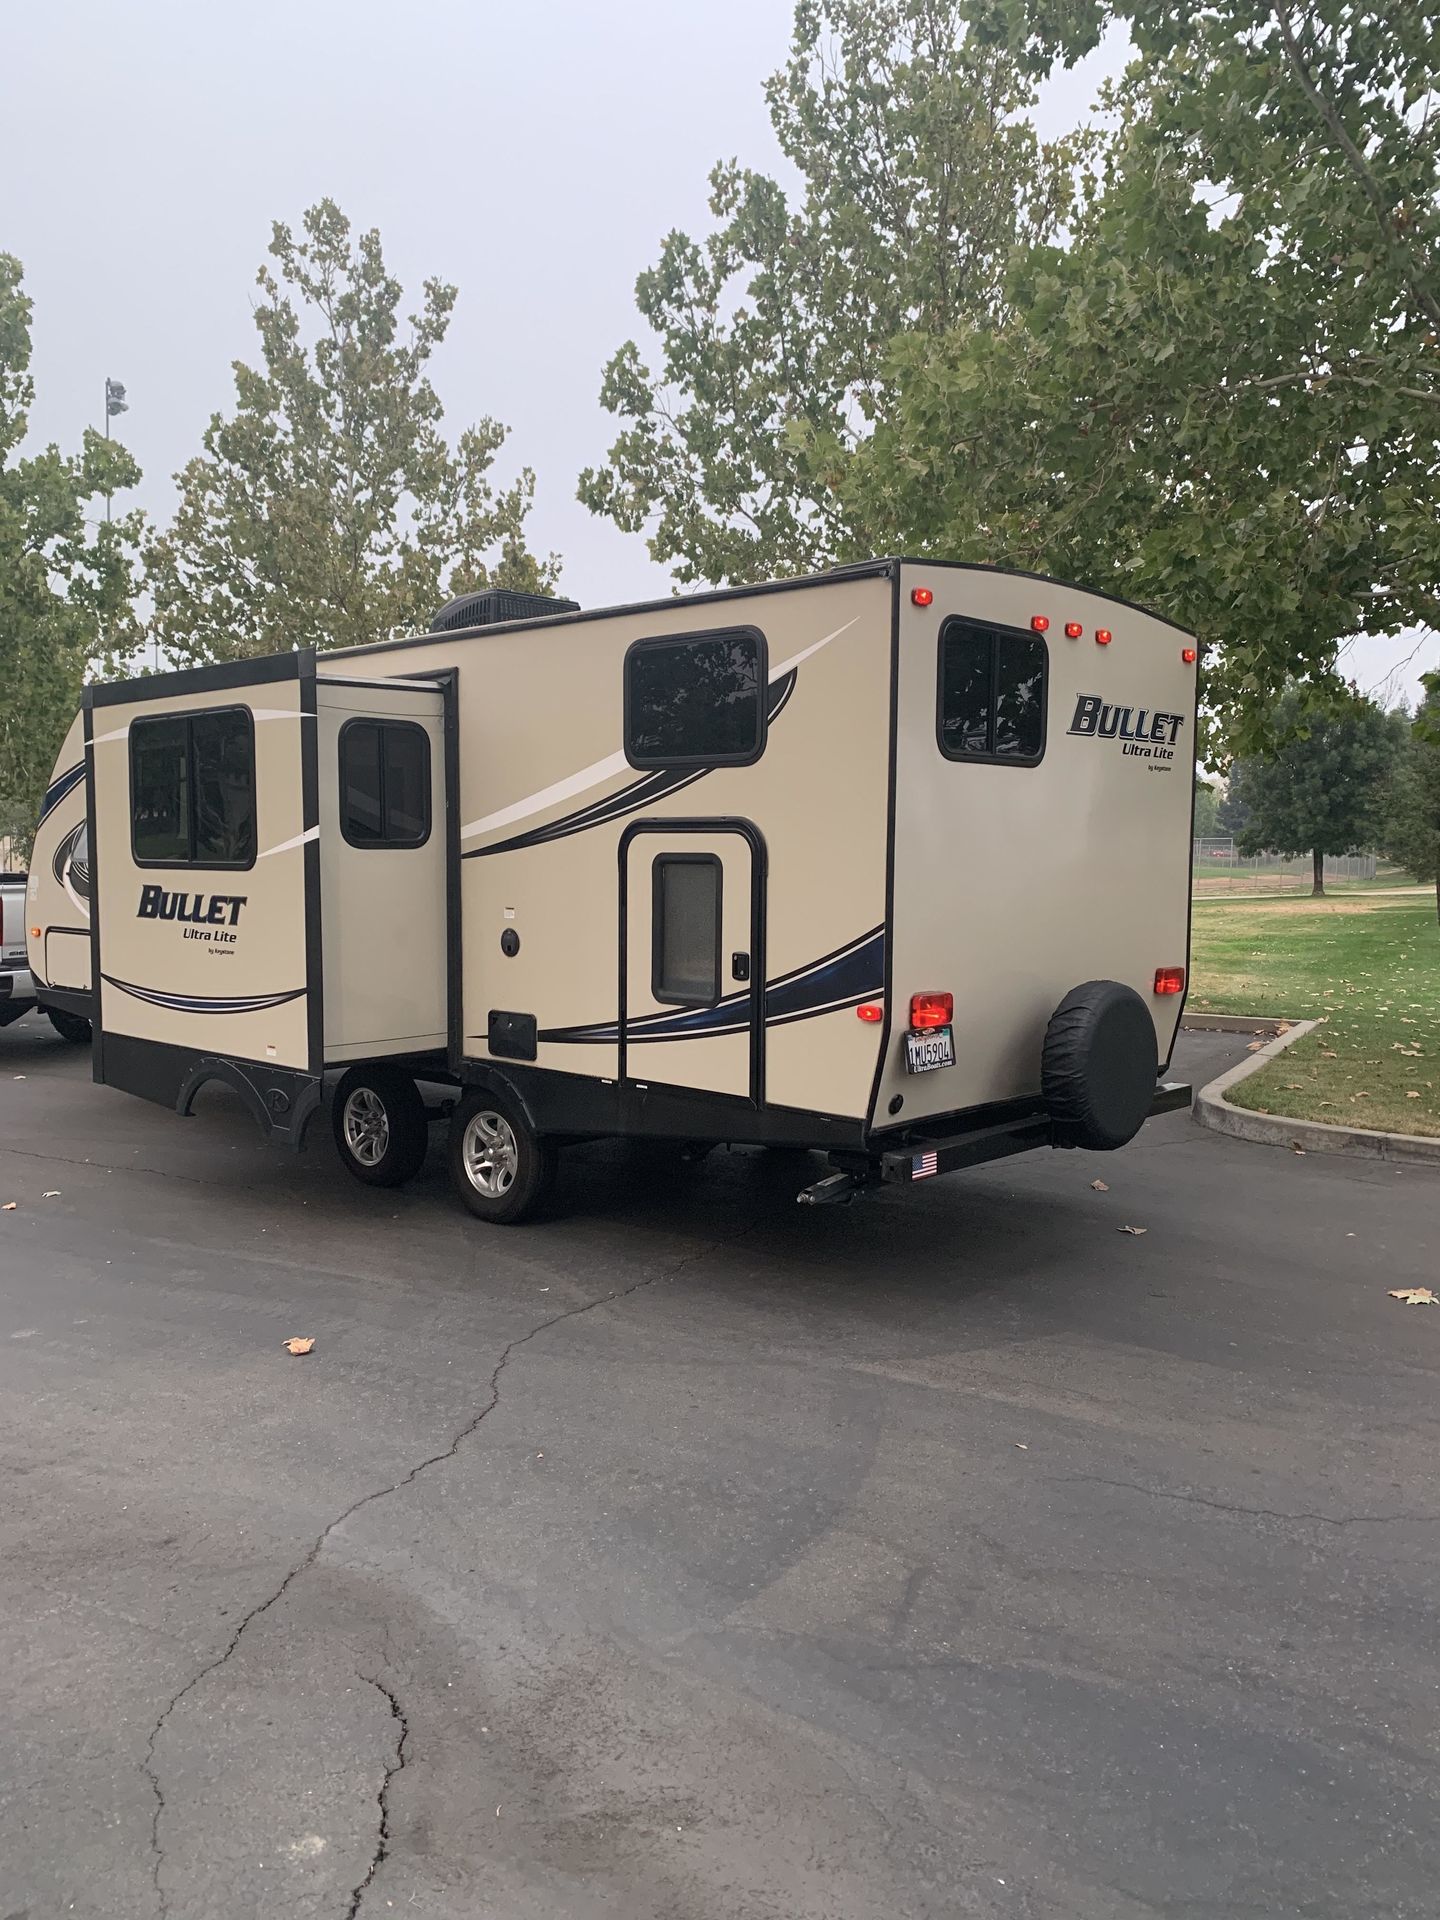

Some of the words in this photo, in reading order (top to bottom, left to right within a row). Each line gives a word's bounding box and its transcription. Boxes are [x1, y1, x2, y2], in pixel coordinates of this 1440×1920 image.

[1066, 693, 1184, 745] BULLET
[1122, 743, 1151, 757] Ultra
[1153, 746, 1174, 760] Lite
[136, 884, 248, 926] BULLET
[183, 928, 211, 941] Ultra
[214, 931, 237, 943] Lite
[909, 1041, 949, 1065] 1MU5904
